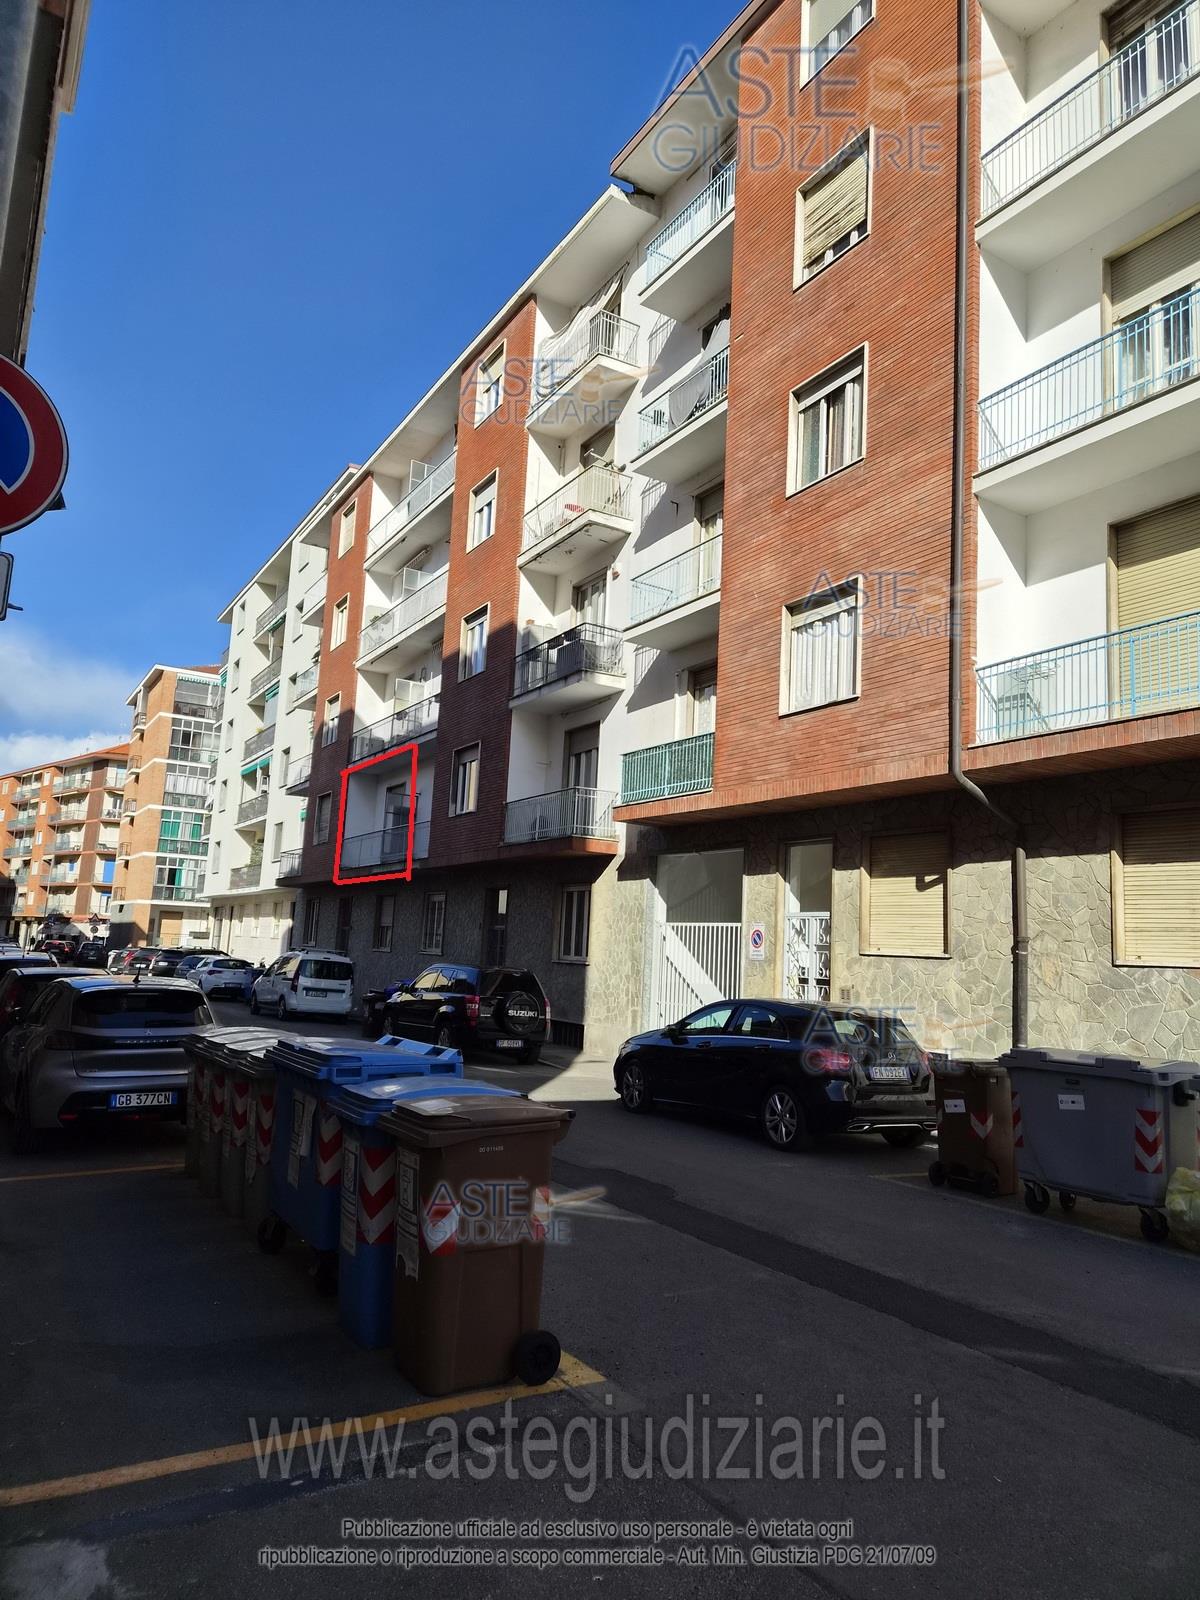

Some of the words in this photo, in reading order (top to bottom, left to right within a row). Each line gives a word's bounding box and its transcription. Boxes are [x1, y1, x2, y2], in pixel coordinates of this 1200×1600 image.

[507, 1009, 538, 1017] SUZUKI
[118, 1094, 132, 1106] GB
[135, 1092, 171, 1105] 377CN
